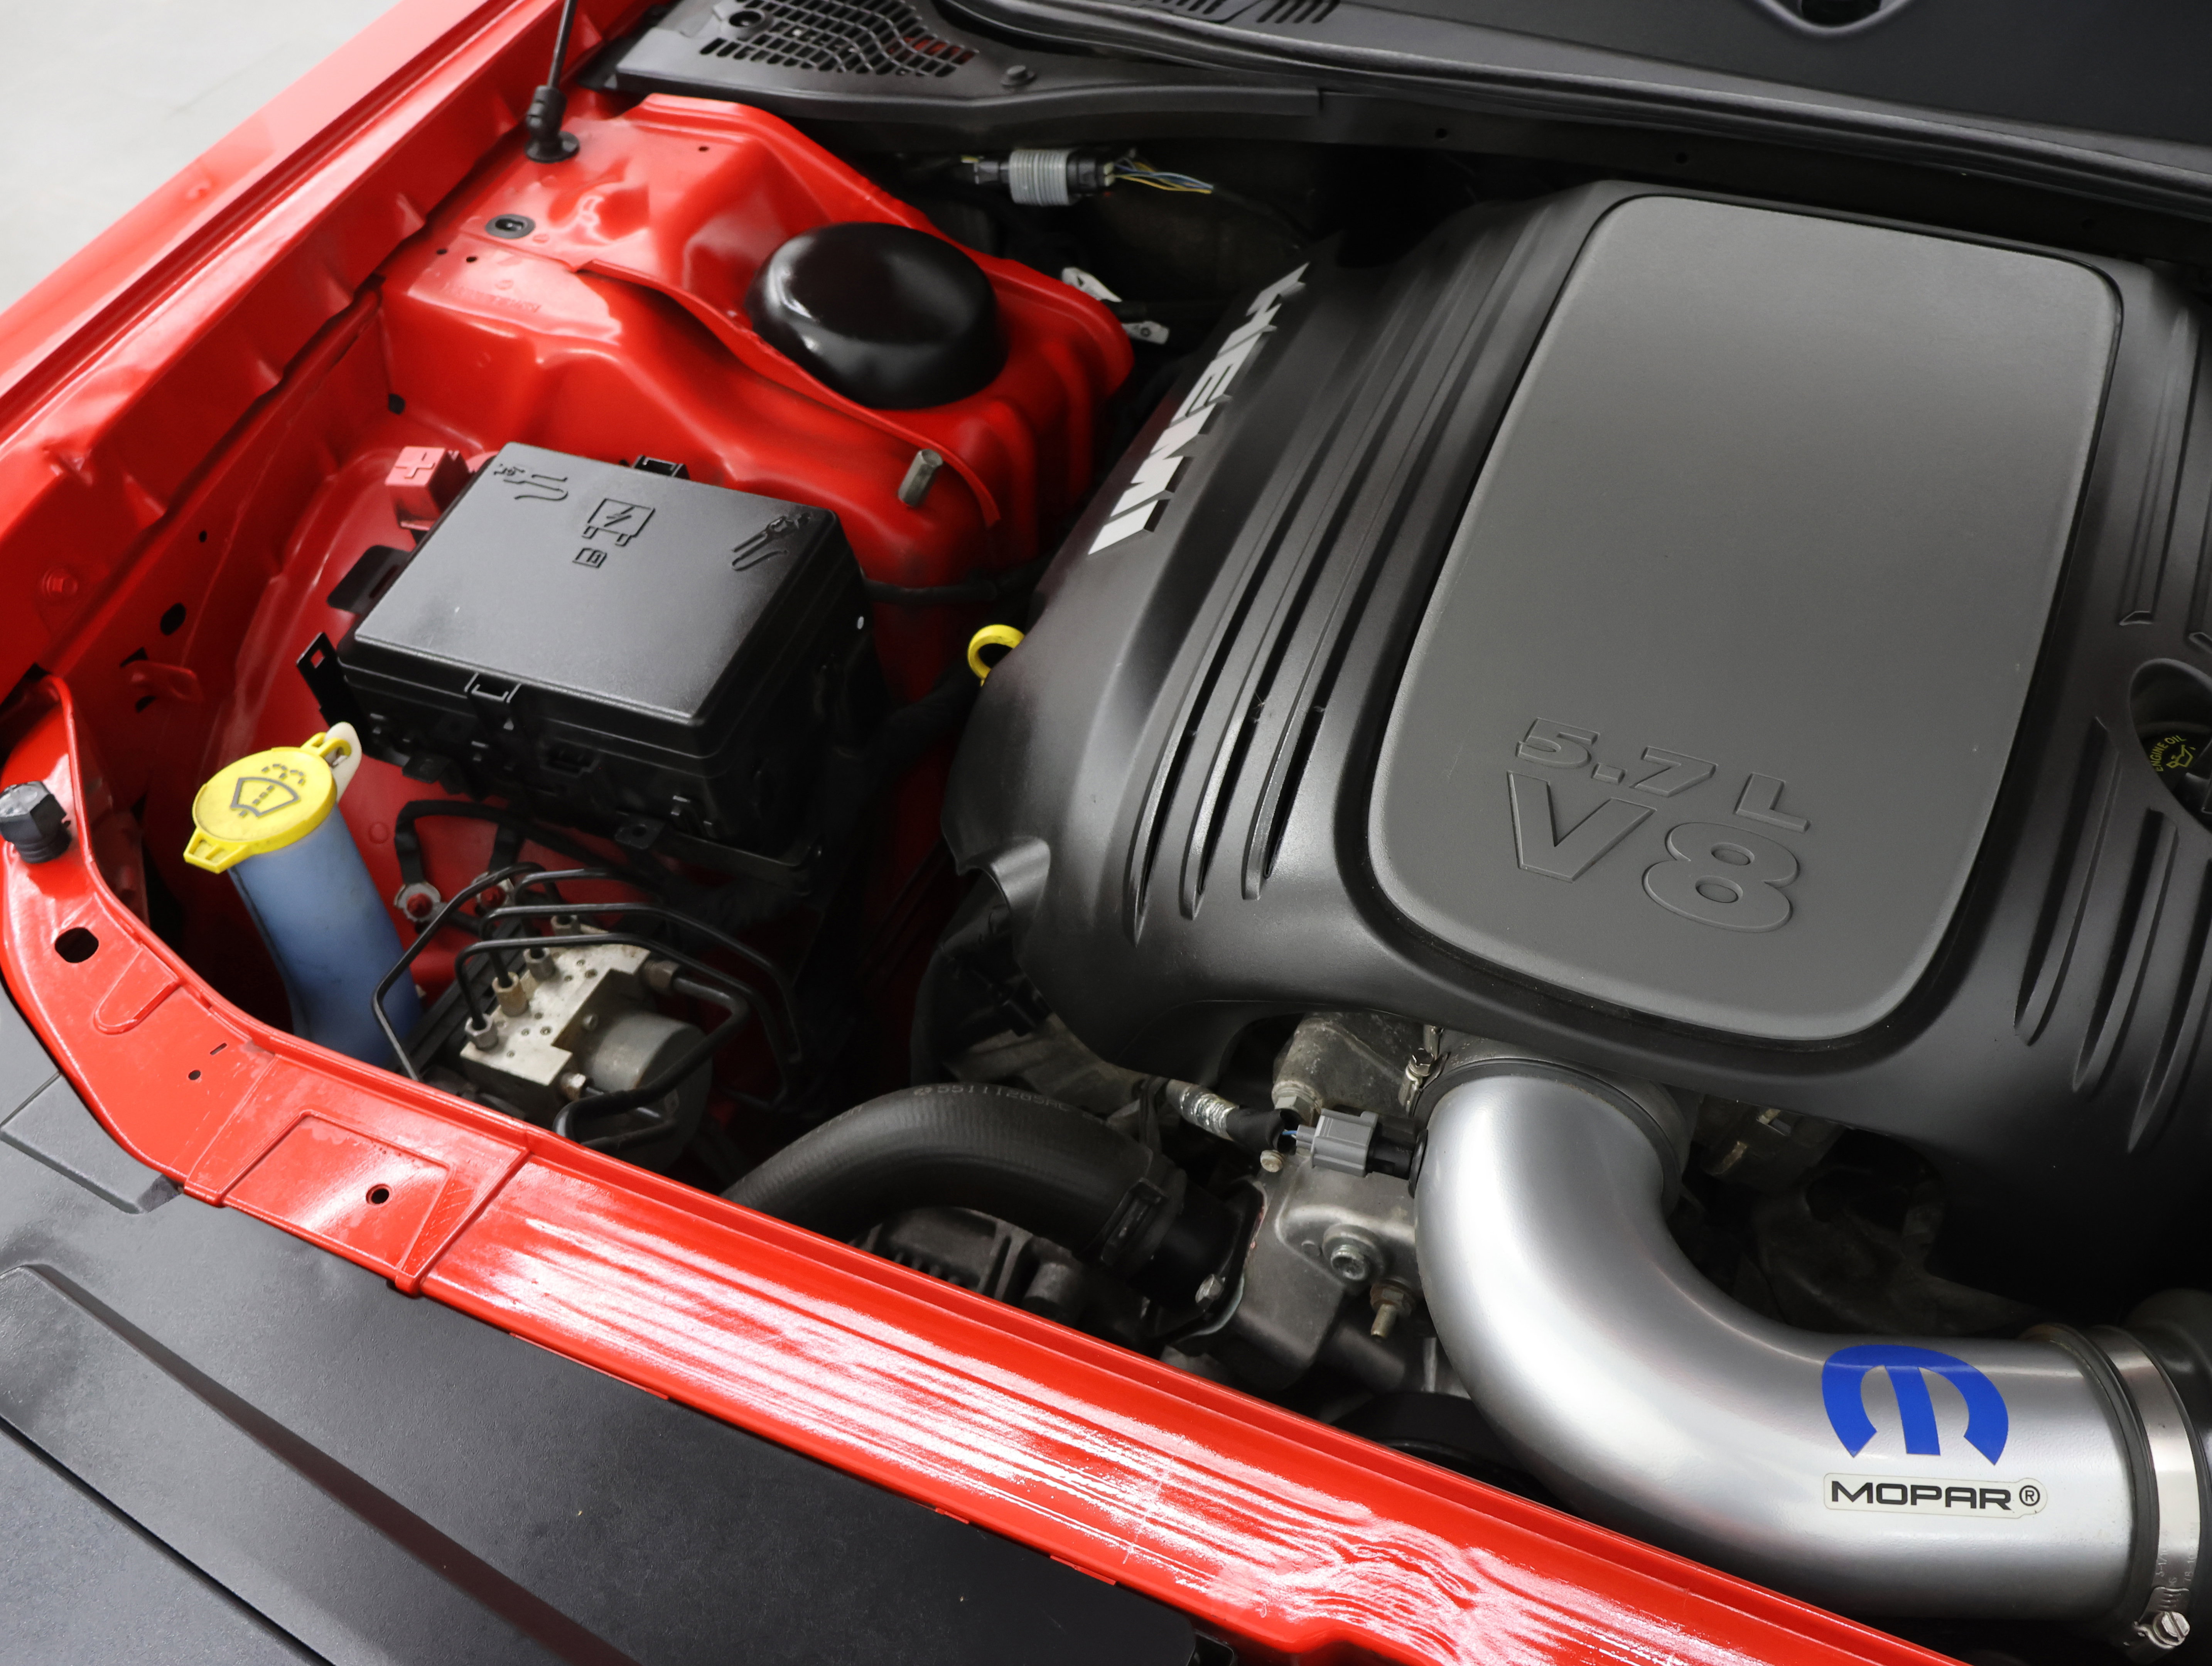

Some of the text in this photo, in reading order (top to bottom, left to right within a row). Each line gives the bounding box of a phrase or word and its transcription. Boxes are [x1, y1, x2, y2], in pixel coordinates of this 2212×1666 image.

[1088, 262, 1309, 555] HEMI
[2150, 735, 2187, 771] ENGINE OIL
[1507, 771, 1800, 933] V8
